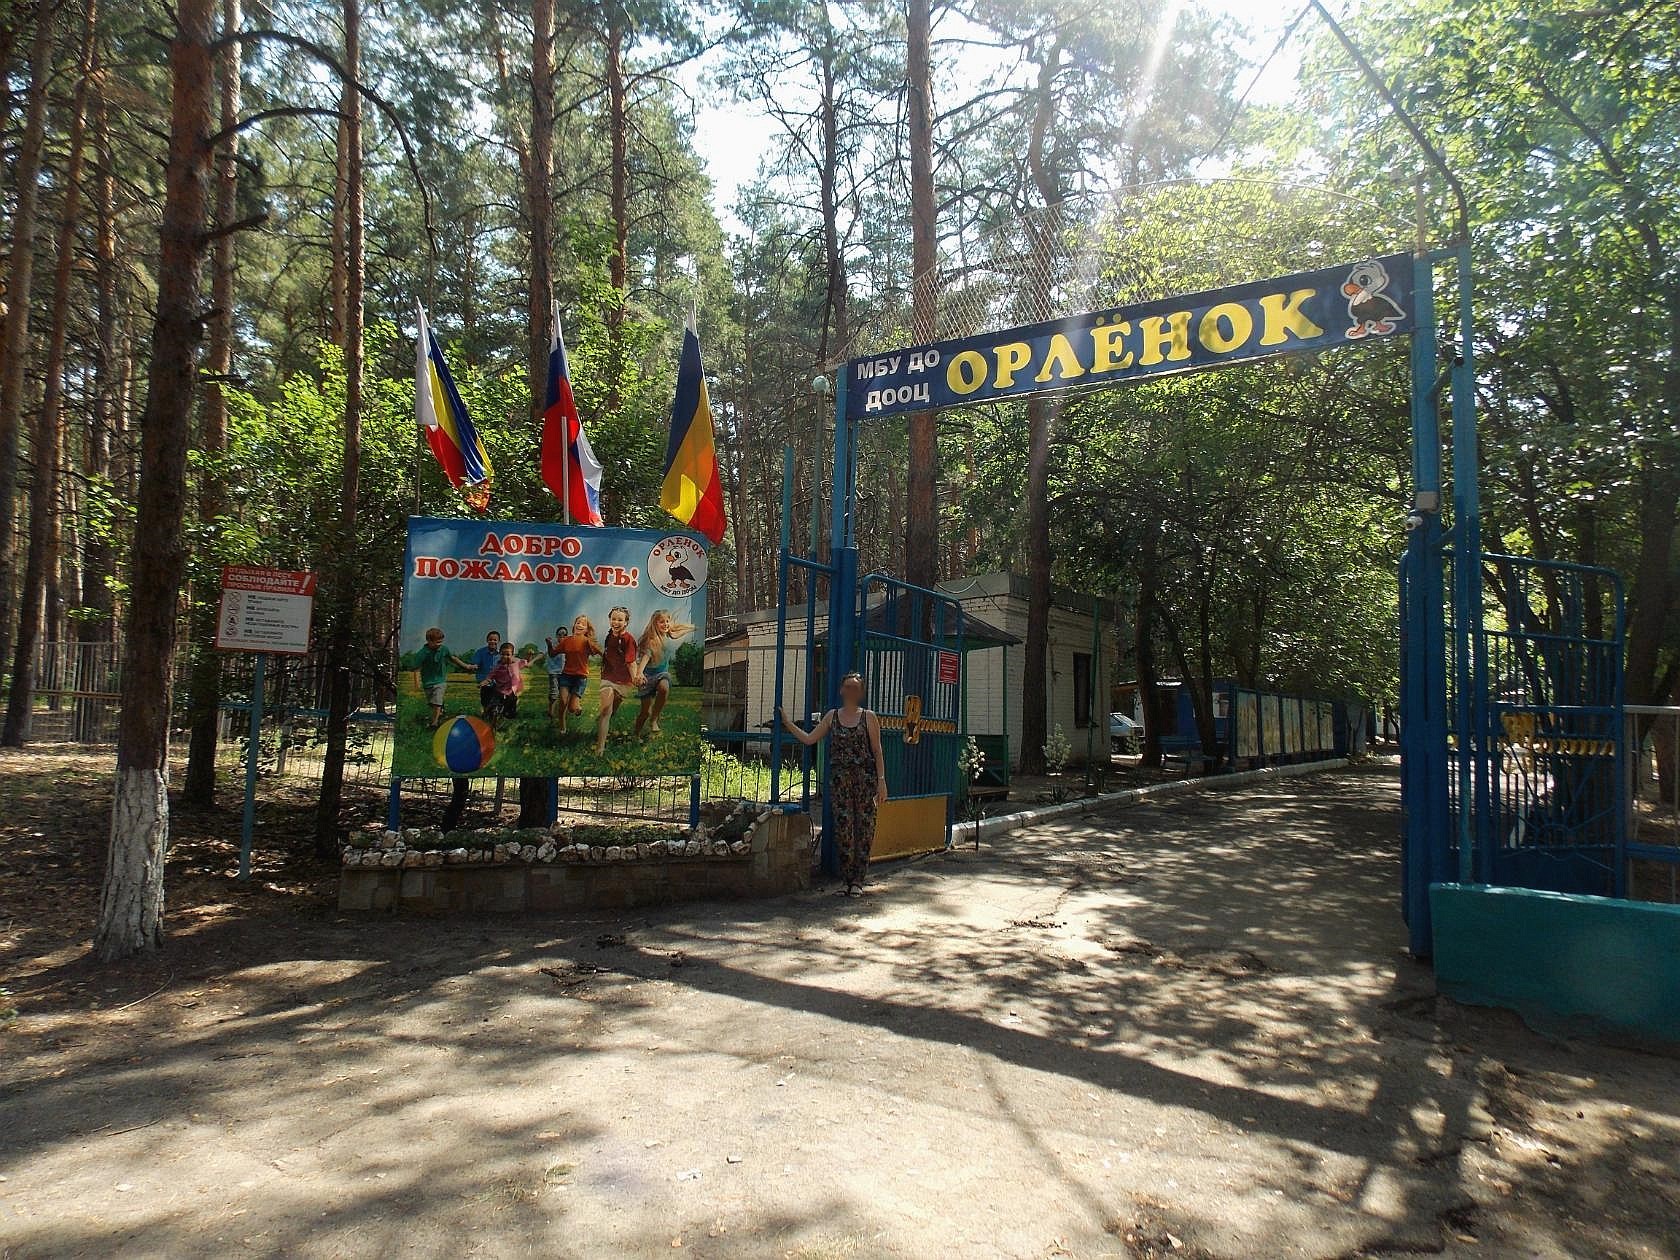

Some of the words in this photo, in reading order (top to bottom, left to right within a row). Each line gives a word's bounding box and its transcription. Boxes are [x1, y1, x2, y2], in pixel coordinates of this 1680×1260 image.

[944, 288, 1324, 396] ОРЛЁНОК
[857, 356, 901, 380] МБУ
[907, 349, 940, 375] ДО
[865, 382, 930, 412] ДООЦ
[480, 533, 582, 558] ДОБРО
[228, 574, 300, 587] СОБЛЮДАЙТЕ
[415, 558, 639, 588] ПОЖАЛОВАТЬ!
